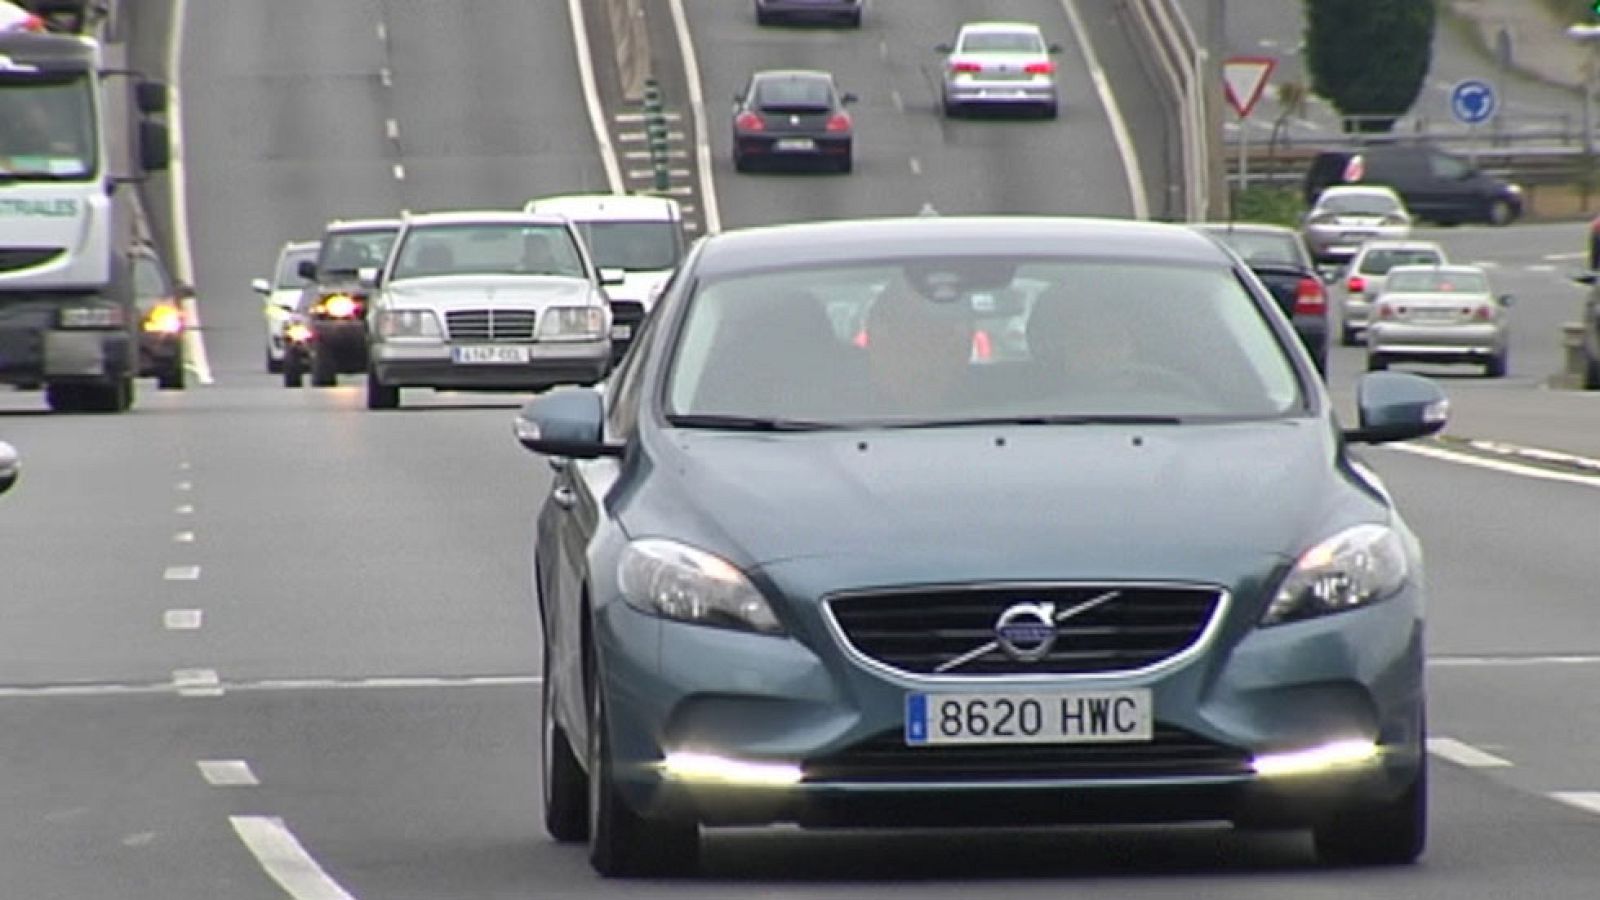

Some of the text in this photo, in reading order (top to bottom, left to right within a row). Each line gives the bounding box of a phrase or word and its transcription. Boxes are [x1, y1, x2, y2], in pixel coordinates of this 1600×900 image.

[0, 198, 77, 217] TRIALES
[940, 696, 1137, 736] 8620 HWC
